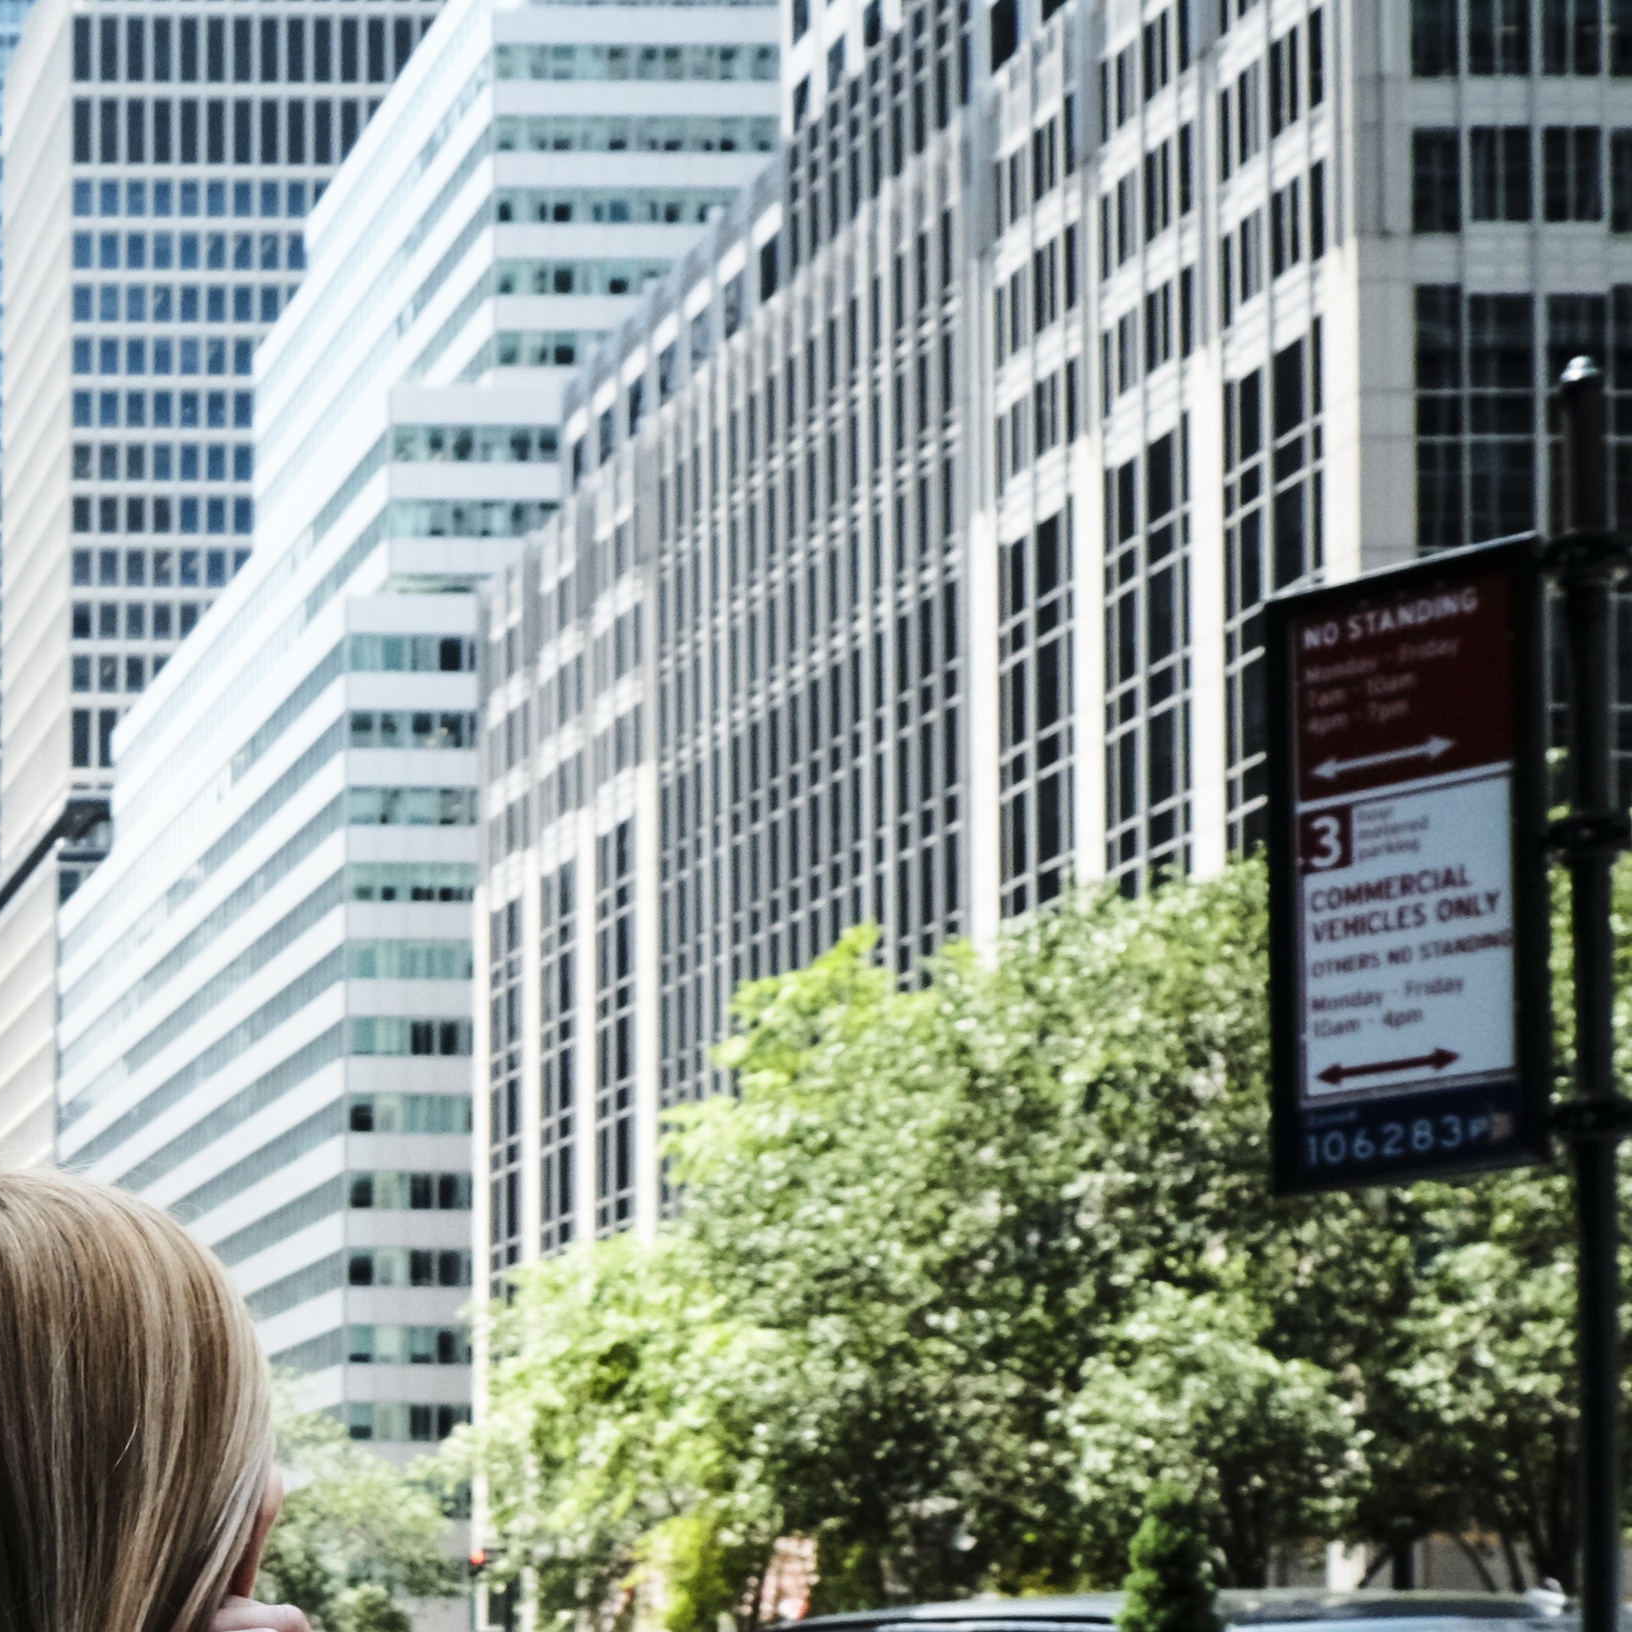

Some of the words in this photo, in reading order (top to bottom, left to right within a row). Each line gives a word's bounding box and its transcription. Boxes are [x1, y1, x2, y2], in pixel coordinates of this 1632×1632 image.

[1304, 621, 1339, 649] NO
[1346, 587, 1478, 641] STANDING
[1310, 815, 1343, 868] 3
[1311, 864, 1473, 914] COMMERCIAL
[1311, 902, 1427, 943] VEHICLES
[1437, 887, 1501, 922] ONLY
[1311, 953, 1381, 978] OTHERS
[1388, 946, 1414, 965] NO
[1419, 928, 1513, 960] STANDING
[1311, 987, 1383, 1013] Monday
[1404, 976, 1464, 1000] Friday
